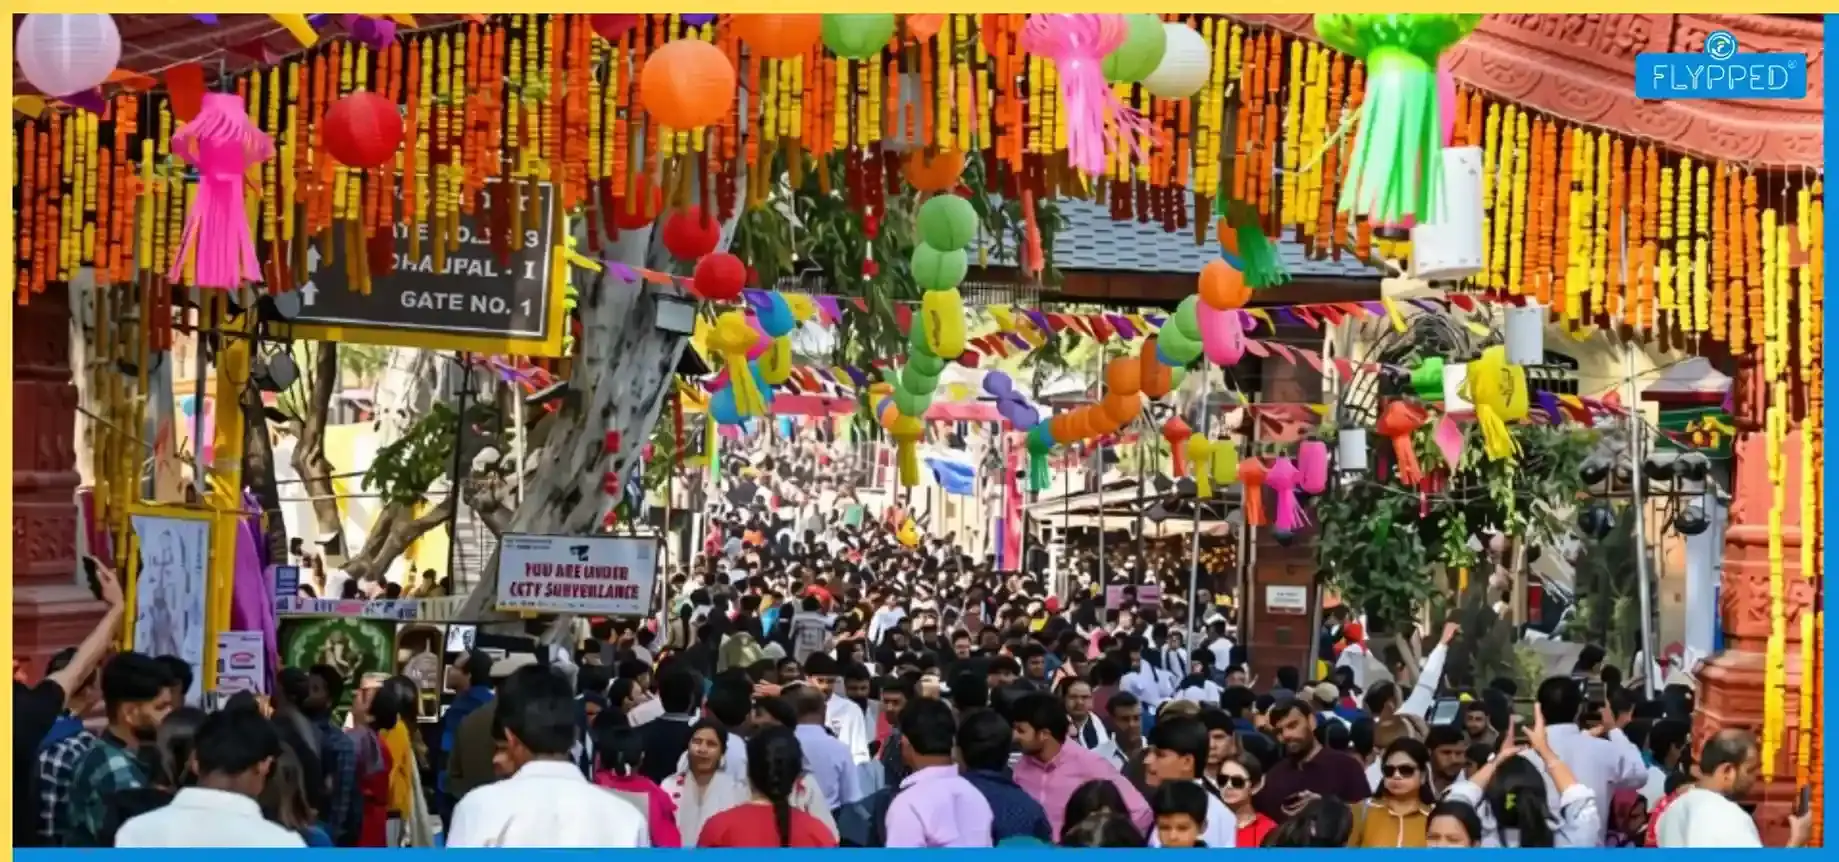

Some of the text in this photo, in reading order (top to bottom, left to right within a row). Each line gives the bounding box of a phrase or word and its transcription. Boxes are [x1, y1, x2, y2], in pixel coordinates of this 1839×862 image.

[525, 230, 539, 248] 3
[400, 290, 531, 317] GATE NO. 1
[525, 562, 629, 581] YOU ARE UNDER
[509, 581, 542, 598] CCTV
